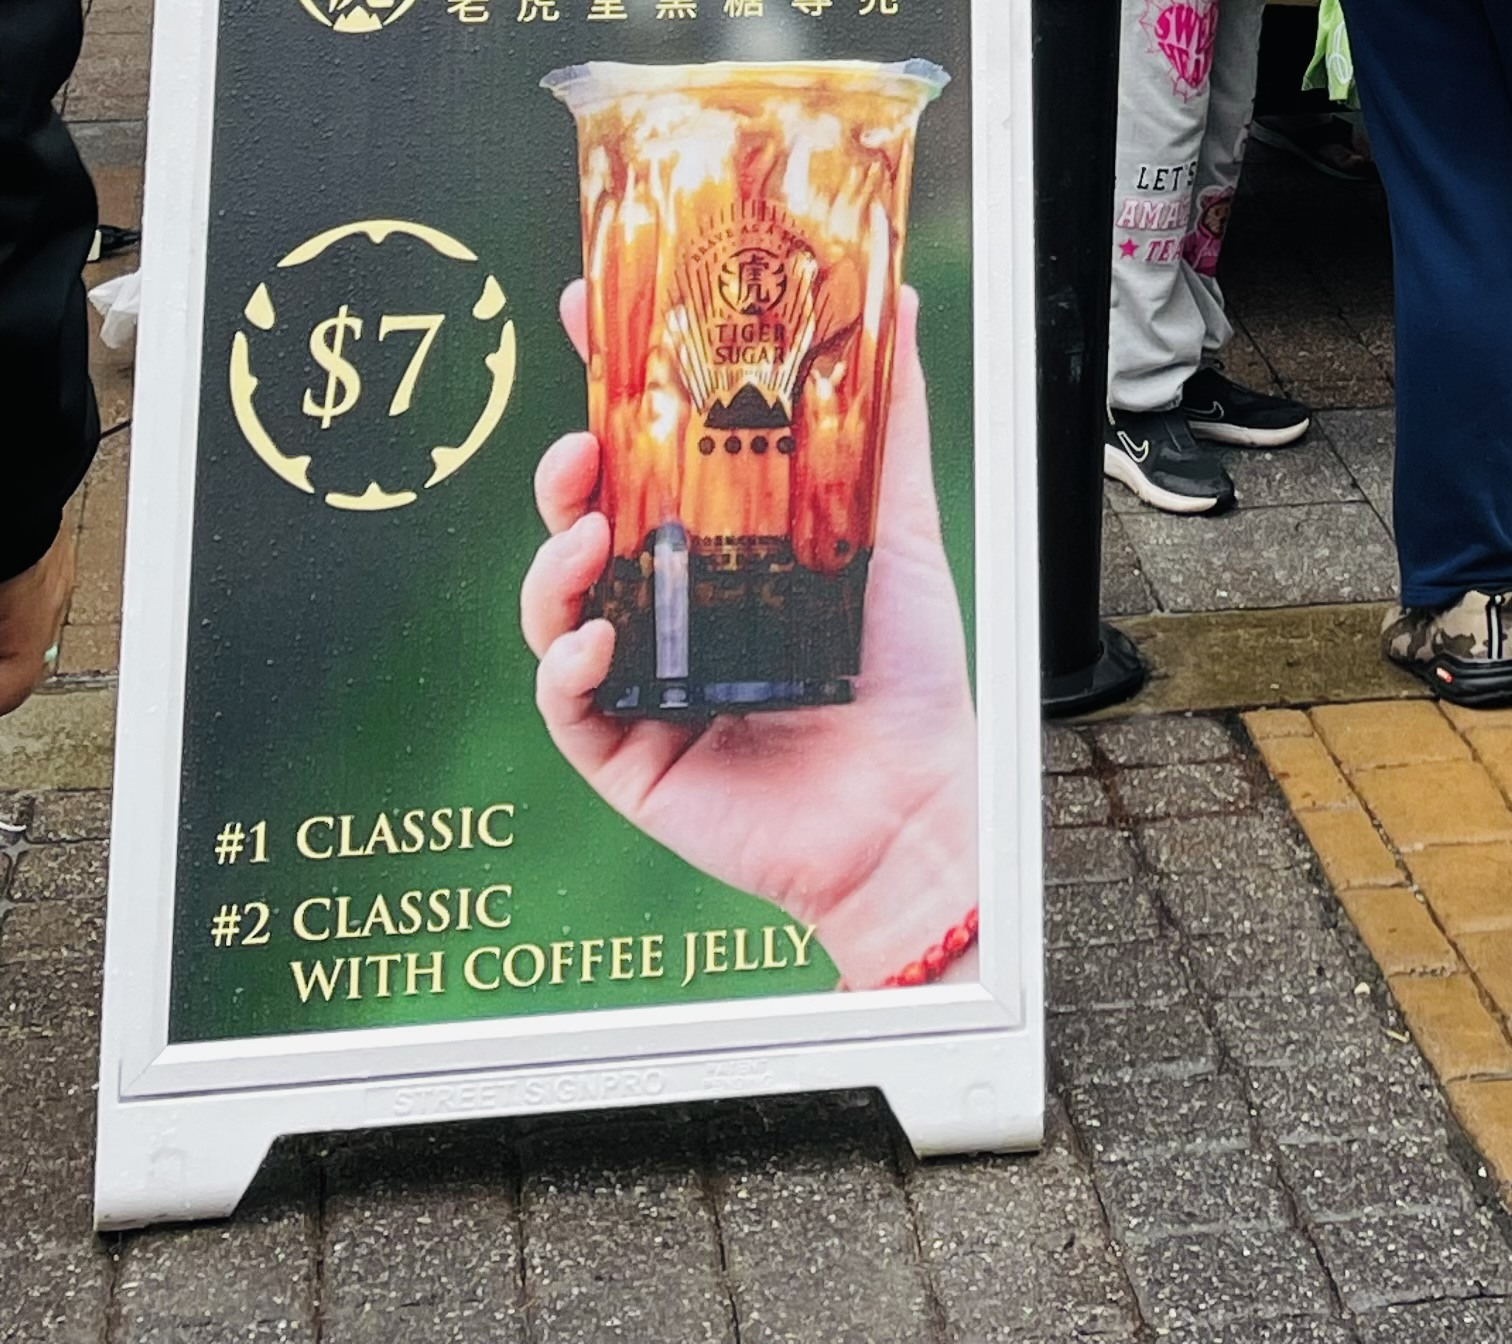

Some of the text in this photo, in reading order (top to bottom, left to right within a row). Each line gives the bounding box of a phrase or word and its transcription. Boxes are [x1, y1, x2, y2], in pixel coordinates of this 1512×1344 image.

[713, 345, 785, 366] SUGAR
[714, 323, 786, 343] TIGER
[302, 304, 446, 429] $7
[214, 803, 515, 865] #1 CLASSIC
[210, 884, 513, 947] #2 CLASSIC
[289, 923, 816, 1004] WITH COFFEE JELLY
